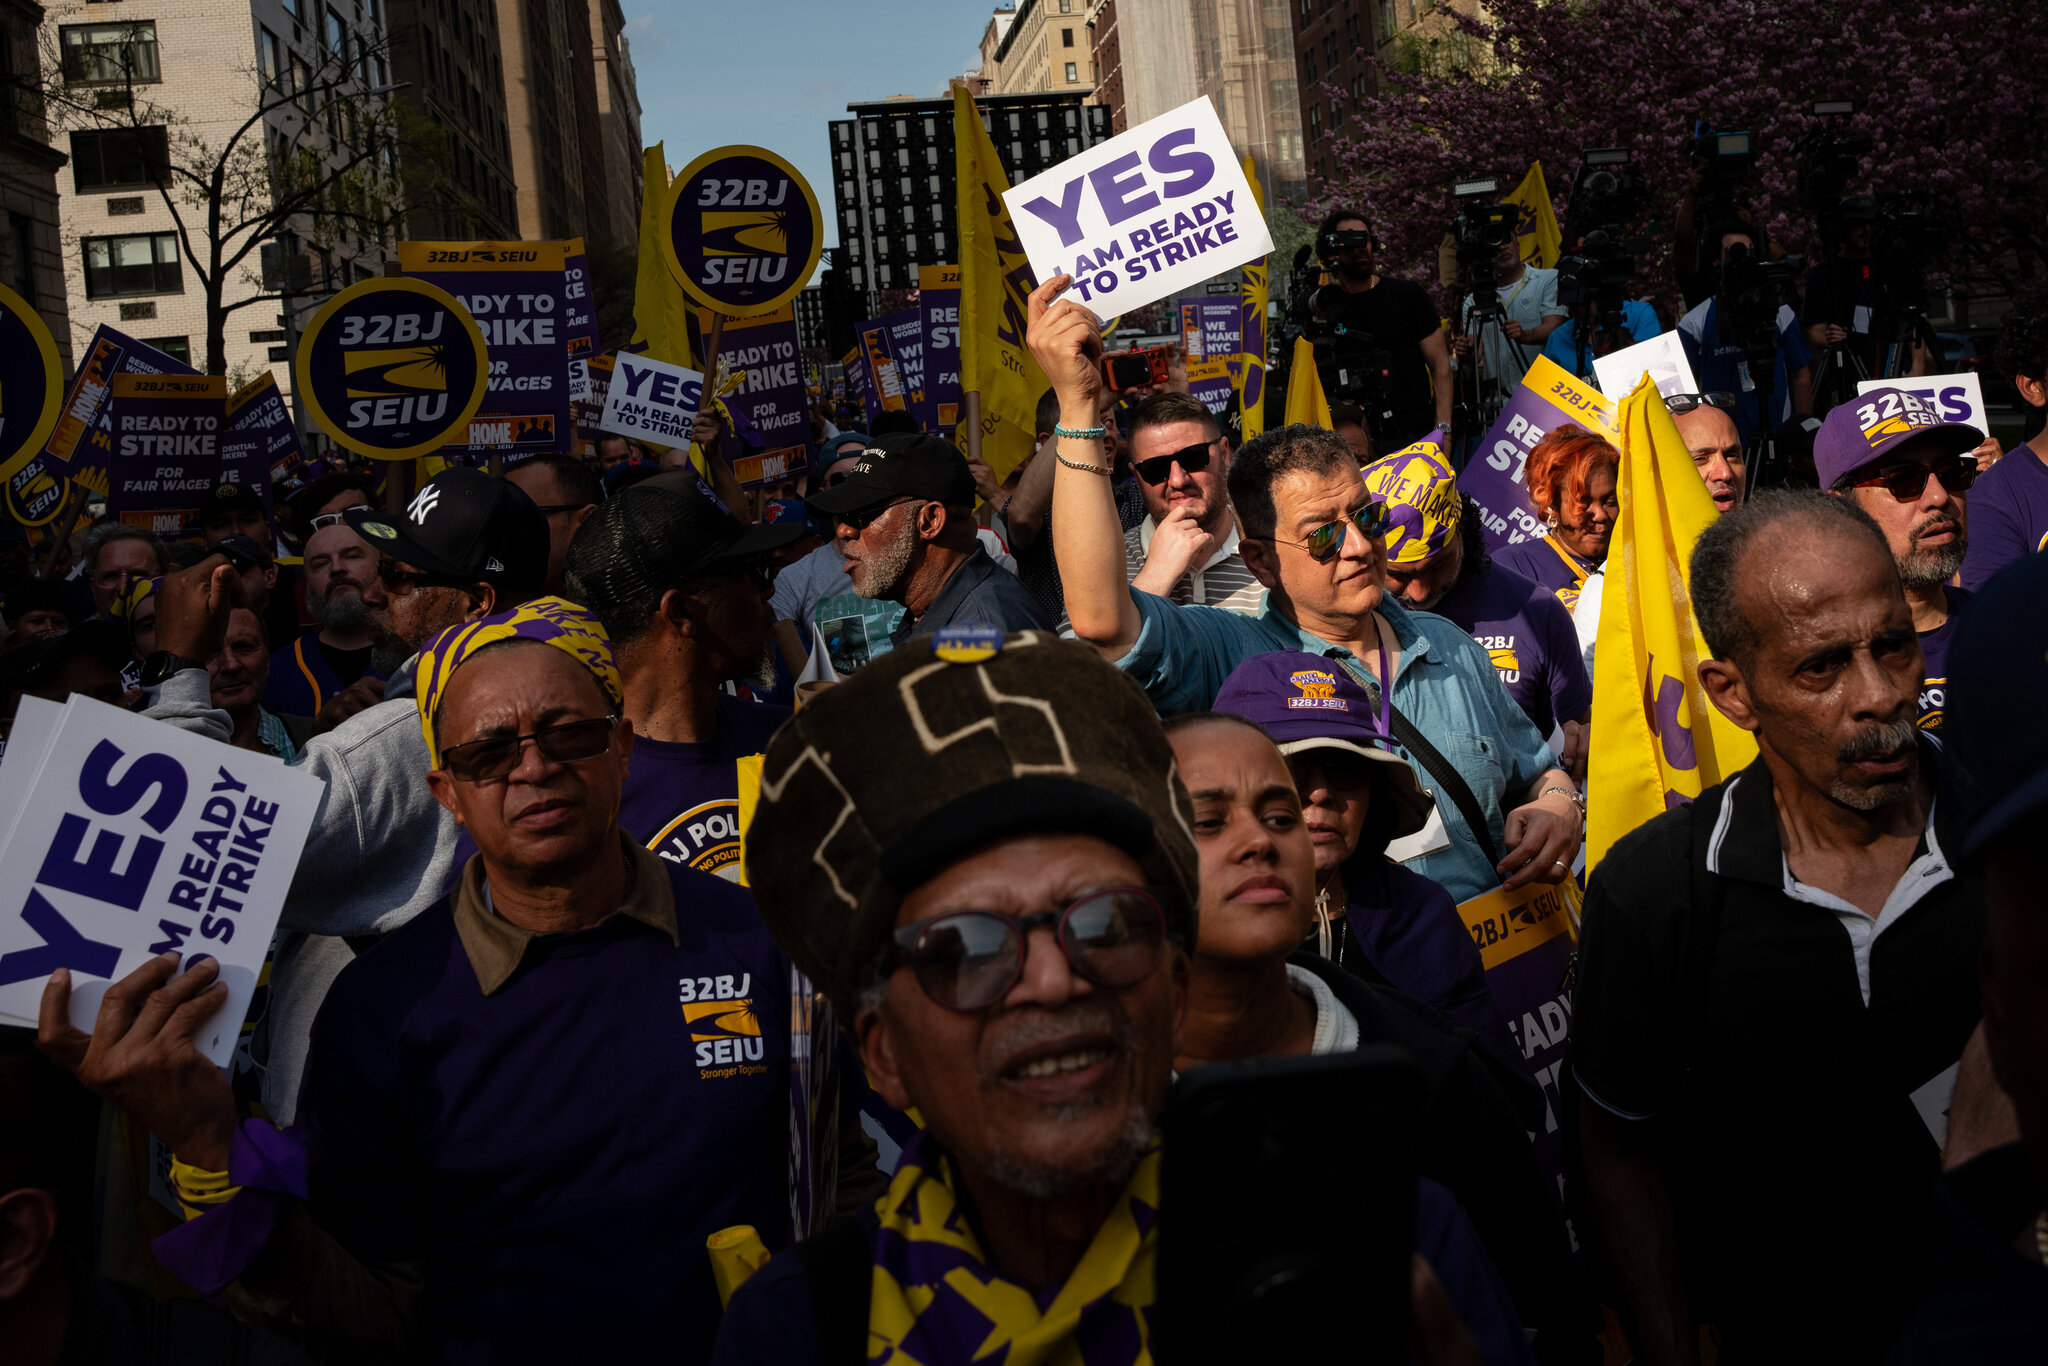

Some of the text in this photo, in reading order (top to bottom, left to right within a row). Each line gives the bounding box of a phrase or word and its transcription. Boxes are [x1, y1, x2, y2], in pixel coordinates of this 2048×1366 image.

[697, 179, 788, 207] 32BJ
[1021, 127, 1215, 248] YES
[1075, 239, 1124, 279] AM
[1128, 190, 1235, 253] READY
[428, 251, 537, 262] 32BJ SEIU
[1071, 219, 1239, 302] TO STRIKE
[702, 257, 788, 284] SEIU
[517, 294, 555, 313] TO
[340, 311, 444, 345] 32BJ
[567, 315, 589, 327] ARE
[1205, 321, 1226, 331] WE
[1187, 331, 1201, 355] HOME
[1206, 331, 1240, 343] MAKE
[1206, 343, 1231, 352] NYC
[718, 341, 793, 369] READY TO
[134, 382, 210, 392] 32BJ SEIU
[569, 380, 586, 389] ADY
[621, 363, 704, 412] YES
[722, 362, 798, 398] RIKE
[70, 379, 105, 423] HOME
[263, 396, 279, 410] TO
[1220, 388, 1232, 399] TO
[1551, 381, 1592, 411] 32BJ
[347, 393, 448, 429] SEIU
[585, 411, 598, 421] FOR
[613, 400, 619, 410] I
[622, 402, 648, 417] AM
[617, 411, 637, 426] TO
[753, 403, 777, 417] FOR
[762, 411, 801, 430] WAGES
[1856, 392, 1938, 431] 32BJ
[121, 416, 187, 431] READY
[193, 416, 218, 431] TO
[469, 422, 512, 444] HOME
[120, 434, 216, 456] STRIKE
[13, 459, 45, 491] 32BJ
[155, 467, 184, 479] FOR
[761, 455, 786, 475] HOME
[123, 480, 158, 492] FAIR
[165, 478, 211, 491] WAGES
[1378, 473, 1411, 499] WE
[29, 484, 60, 519] SEIU
[407, 484, 440, 526] NY
[153, 514, 181, 532] HOME
[1507, 507, 1550, 539] FOR
[1291, 699, 1345, 708] 32BJ SEIU
[167, 766, 248, 913] READY
[0, 738, 188, 986] YES
[200, 795, 280, 944] STRIKE
[1472, 889, 1562, 949] 2BJ SEIU
[679, 972, 751, 1002] 32BJ
[695, 1037, 764, 1067] SEIU
[700, 1064, 767, 1080] Stronger Together
